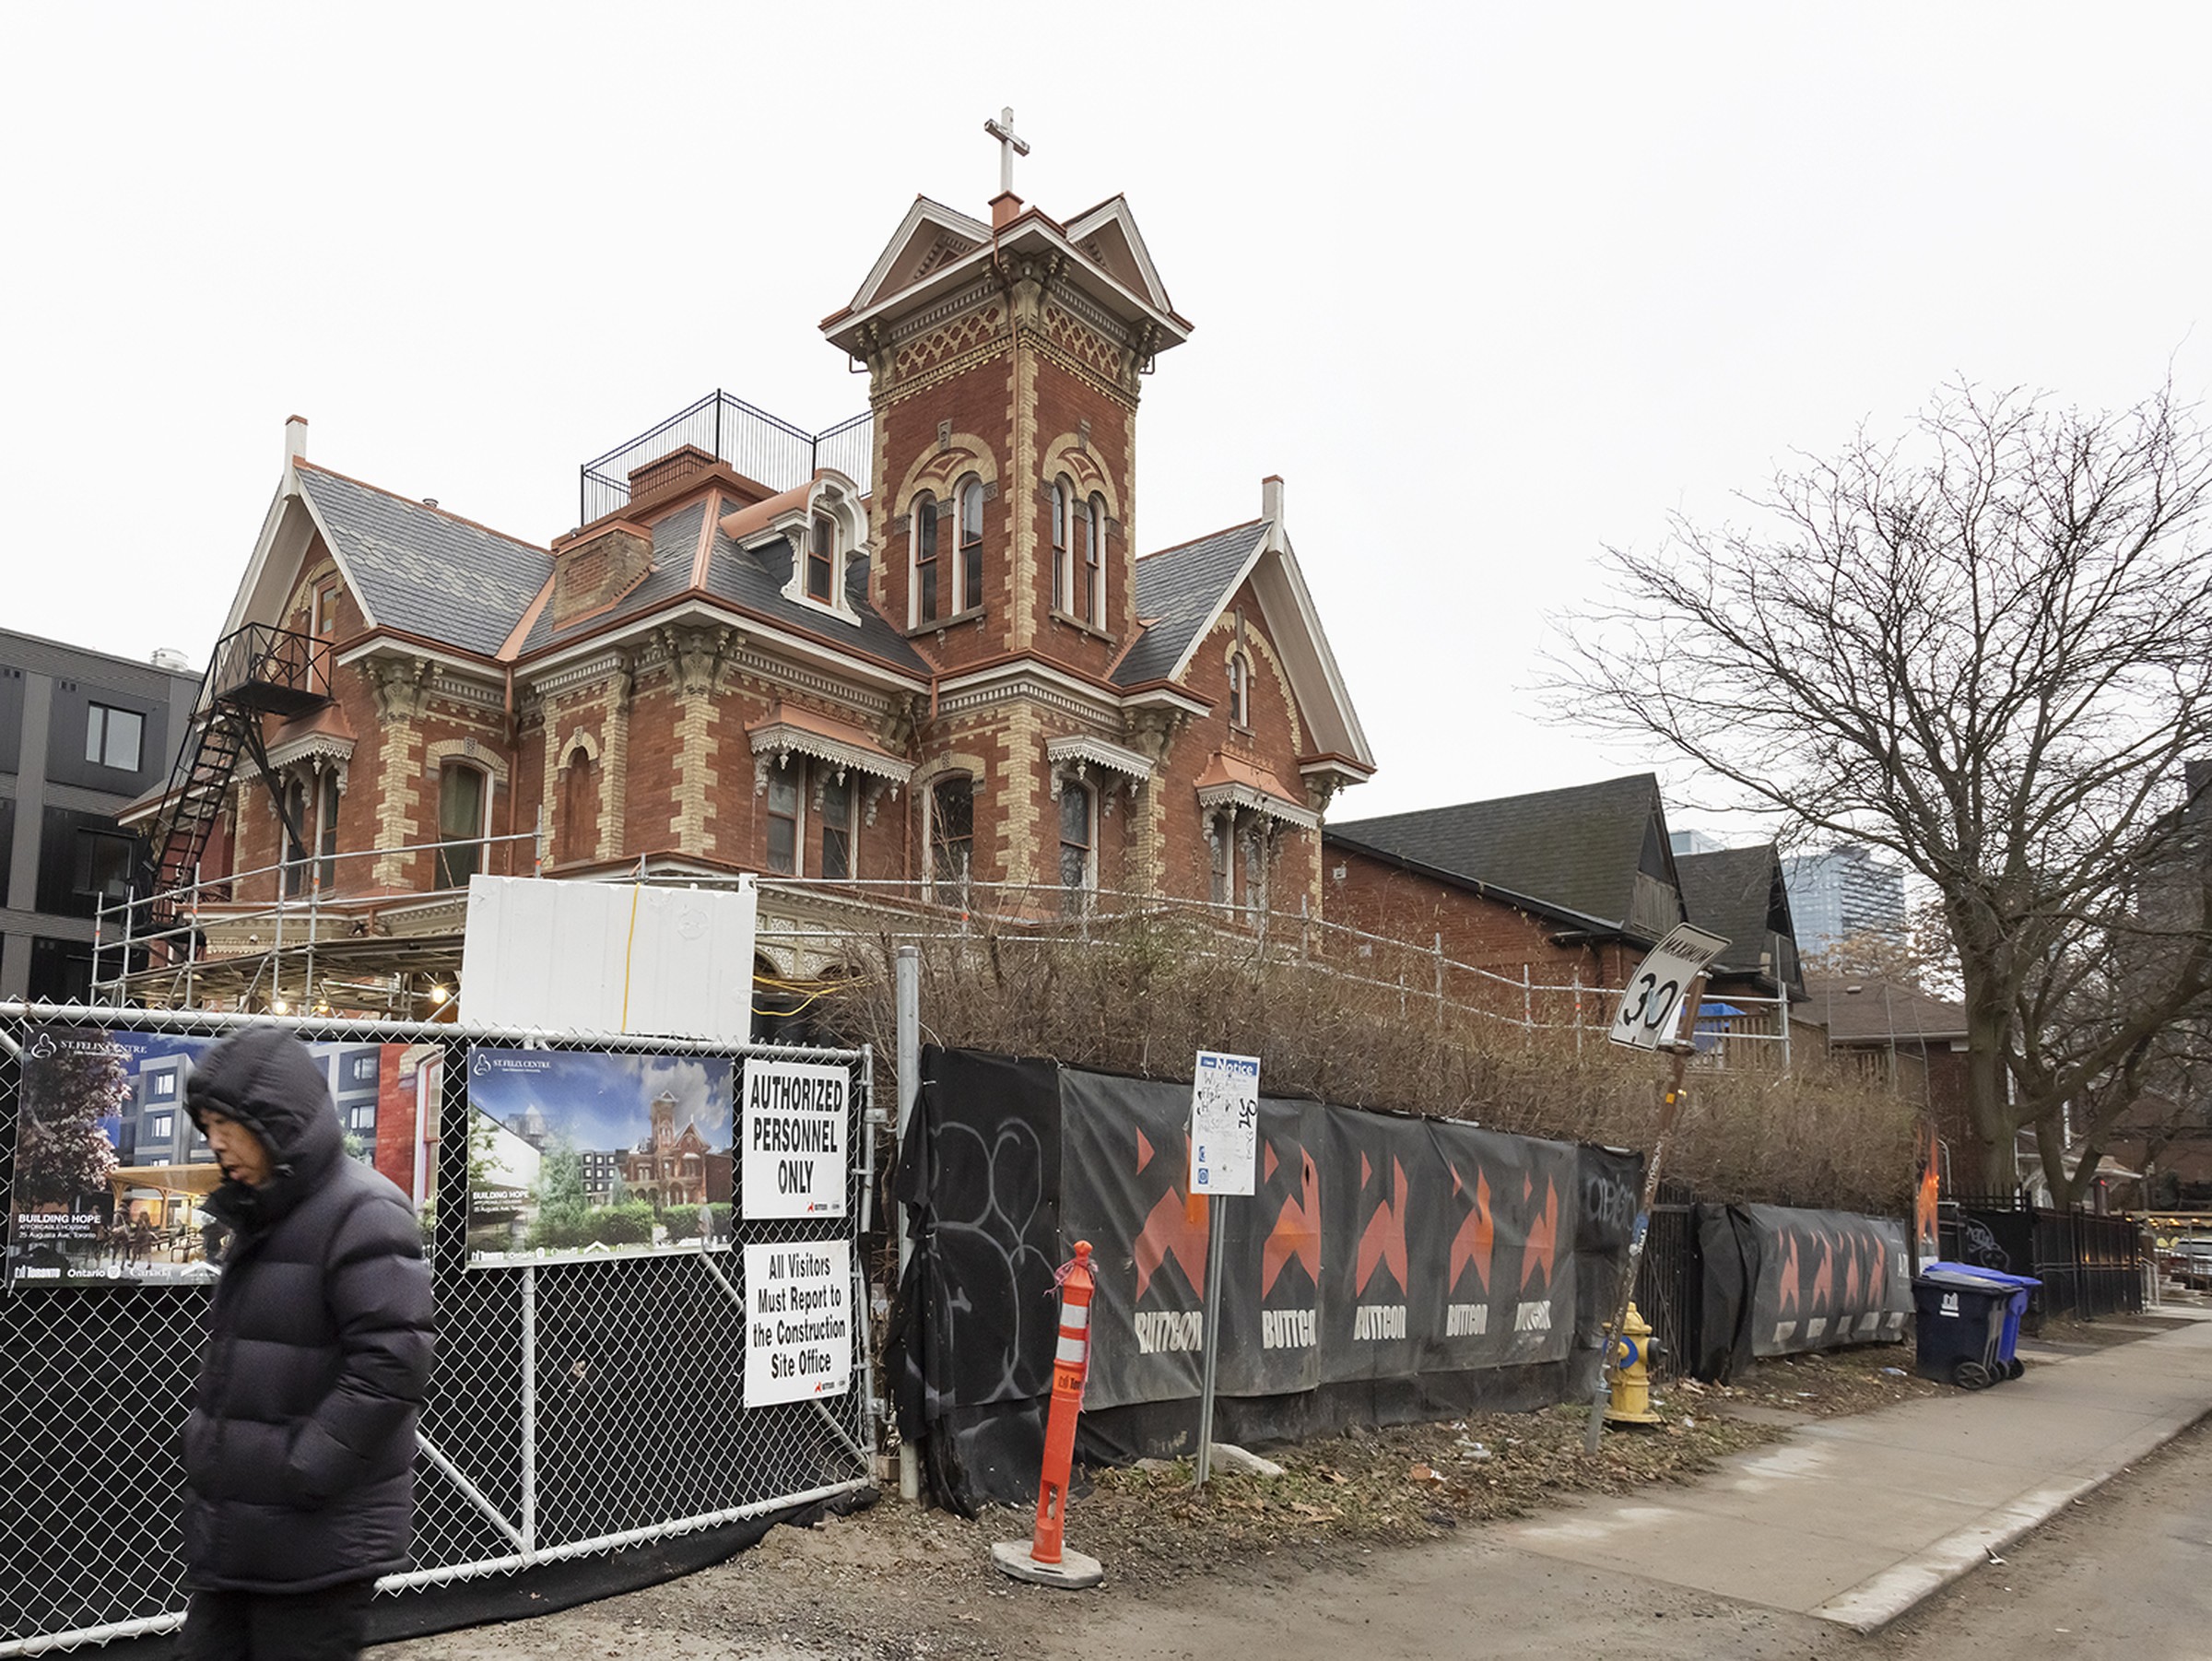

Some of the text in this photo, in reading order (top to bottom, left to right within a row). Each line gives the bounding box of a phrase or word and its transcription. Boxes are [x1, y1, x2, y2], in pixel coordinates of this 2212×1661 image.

[1664, 937, 1714, 965] MAXIMUM
[1623, 972, 1678, 1030] 30
[76, 1041, 106, 1052] FELIX
[1217, 1057, 1253, 1076] Notice
[750, 1075, 842, 1113] AUTHORIZED
[753, 1116, 838, 1153] PERSONNEL
[778, 1160, 814, 1195] ONLY
[473, 1191, 508, 1199] BUILDING
[18, 1214, 101, 1224] BUILDING HOPE
[29, 1231, 55, 1240] Augusta
[67, 1267, 105, 1278] Ontario
[769, 1252, 831, 1279] All Visitors
[758, 1284, 841, 1315] Must Report to
[753, 1313, 846, 1348] the Construction
[1353, 1304, 1406, 1341] BUTTCON
[1446, 1303, 1488, 1337] BUTTCON
[771, 1348, 831, 1380] Site Office
